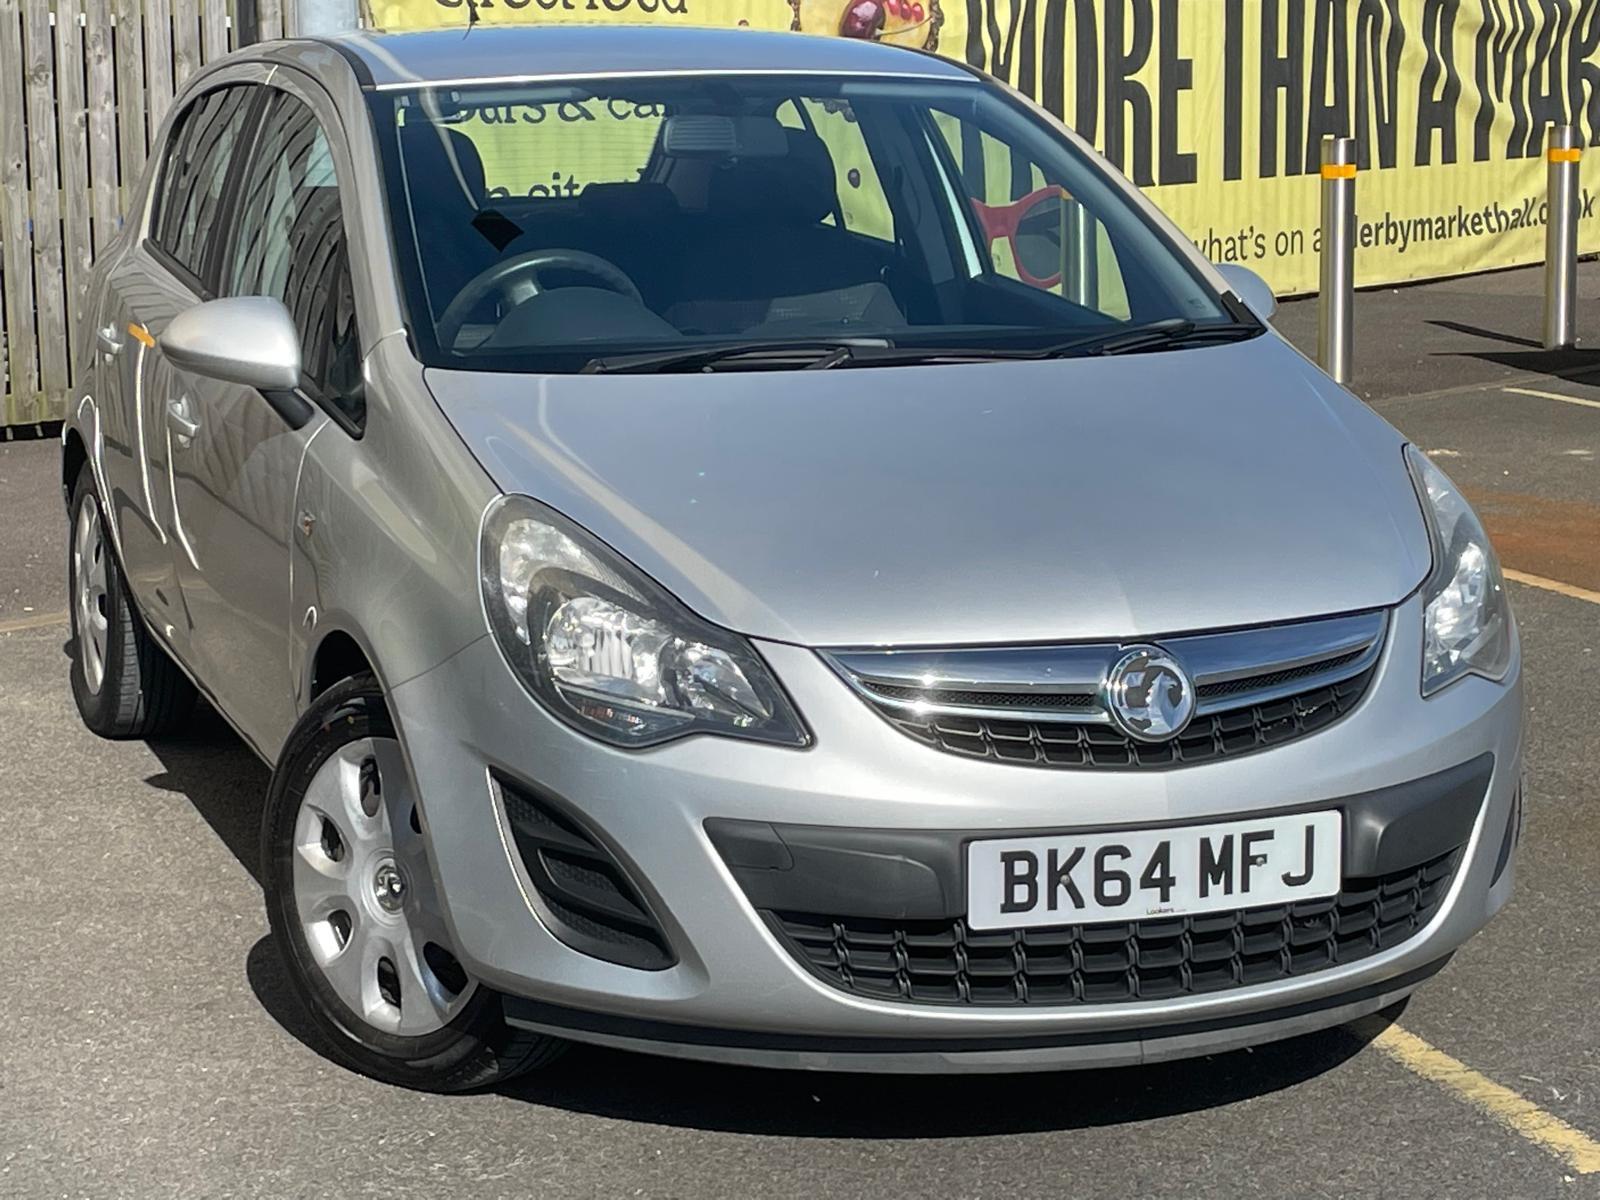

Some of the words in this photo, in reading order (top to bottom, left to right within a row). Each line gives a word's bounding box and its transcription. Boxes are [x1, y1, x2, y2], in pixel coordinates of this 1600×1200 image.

[1222, 0, 1402, 182] THAN
[1414, 0, 1462, 168] A
[1275, 229, 1304, 257] on
[1000, 841, 1177, 914] BK64
[1199, 825, 1315, 898] MFJ
